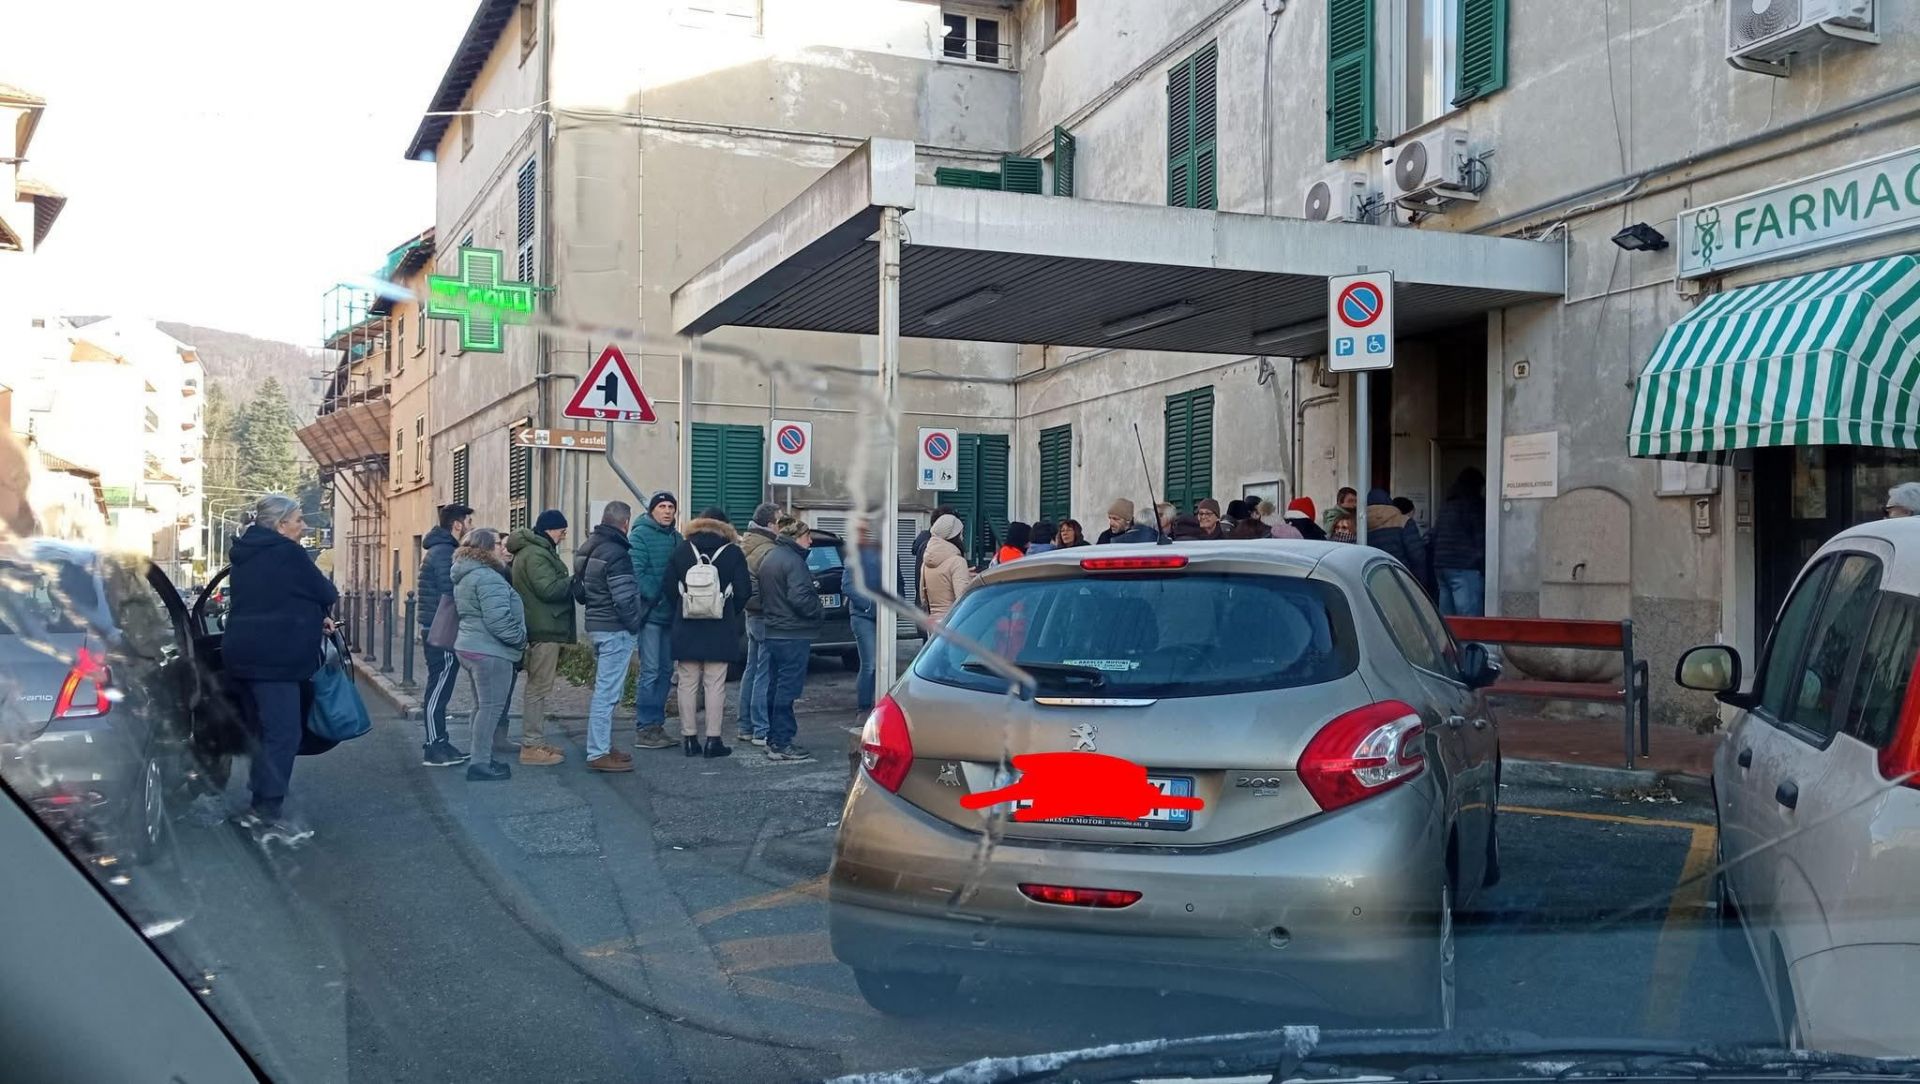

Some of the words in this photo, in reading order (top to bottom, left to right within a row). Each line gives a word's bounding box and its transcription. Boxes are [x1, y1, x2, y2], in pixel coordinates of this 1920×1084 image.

[1735, 164, 1920, 249] FARMAC
[1339, 339, 1350, 354] P
[580, 436, 607, 445] castell
[777, 463, 786, 475] P
[1236, 777, 1280, 789] 208
